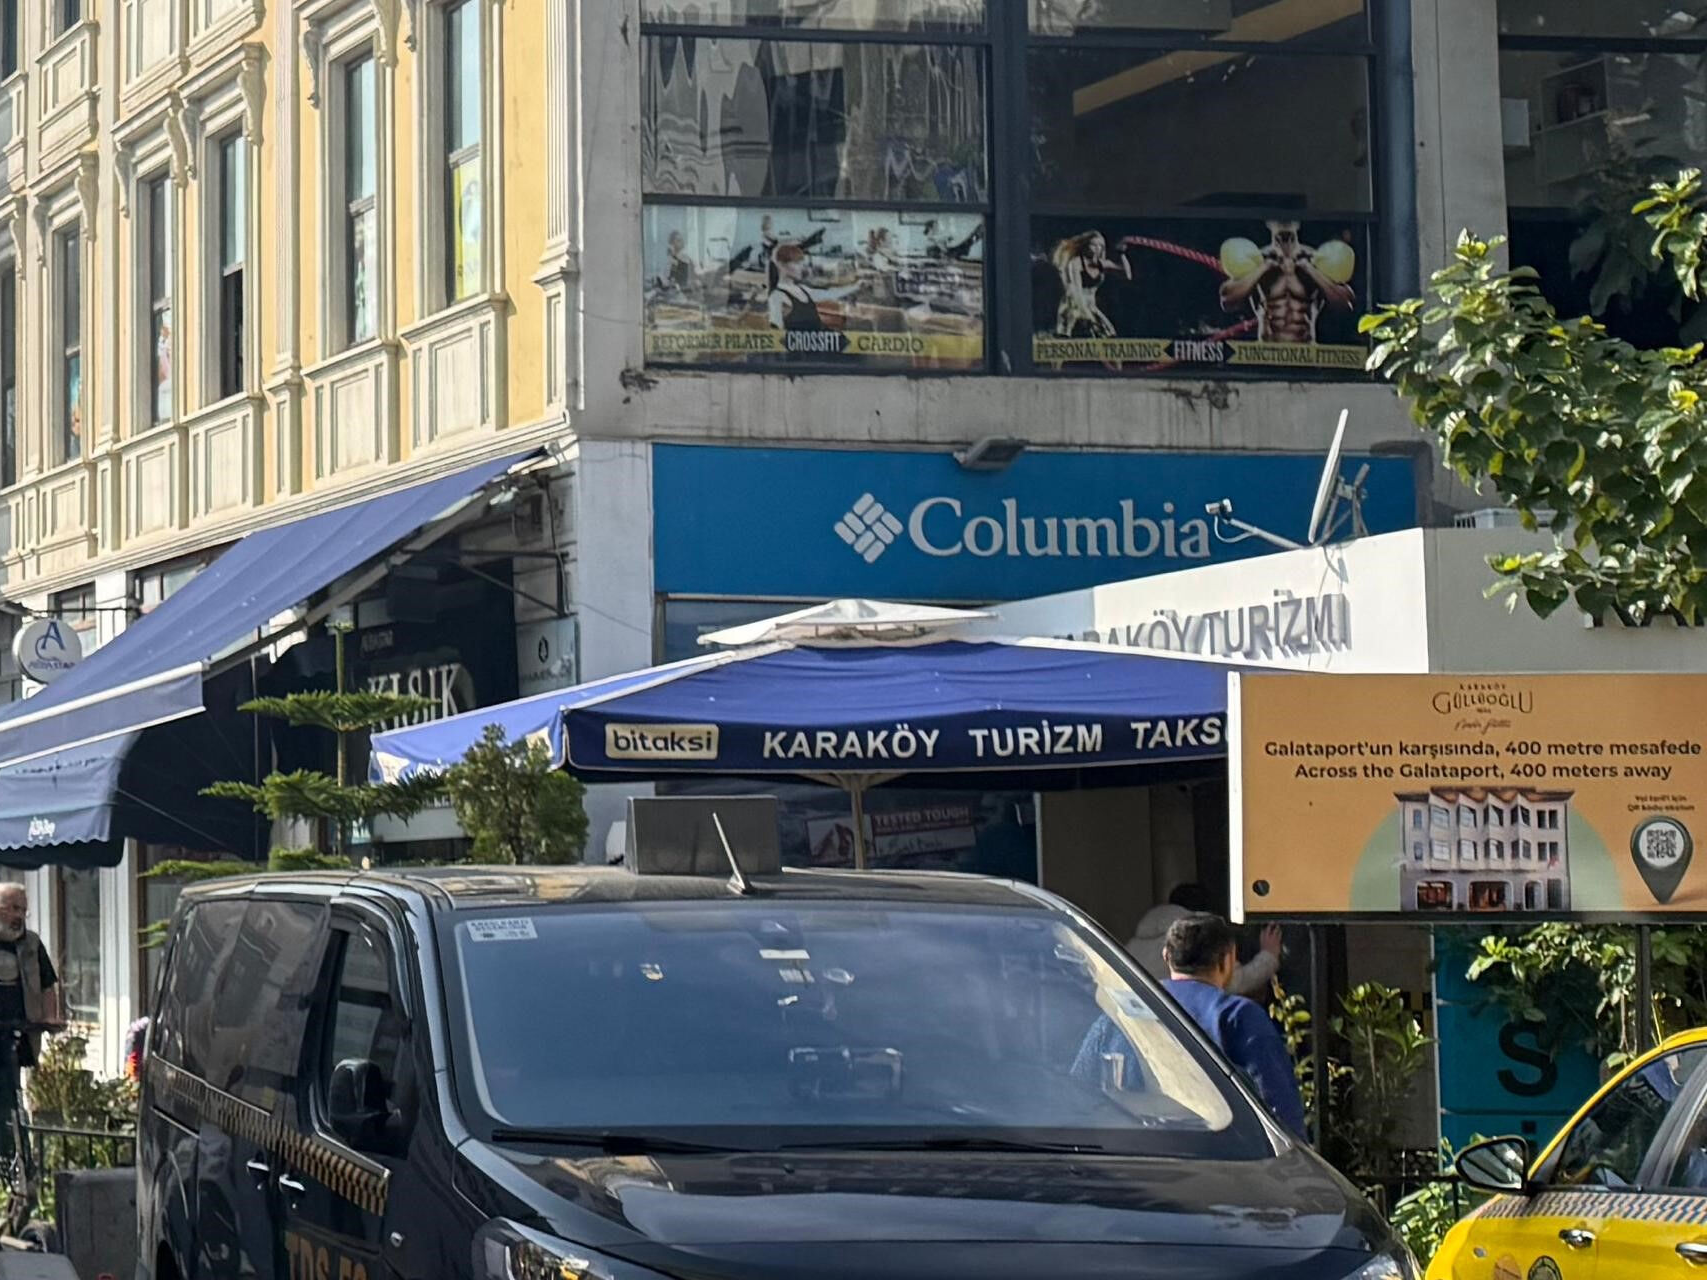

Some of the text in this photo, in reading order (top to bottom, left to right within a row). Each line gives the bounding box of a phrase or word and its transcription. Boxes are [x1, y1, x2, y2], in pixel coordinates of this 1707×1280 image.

[724, 332, 775, 350] PILATES
[787, 332, 841, 352] CROSSFIT
[857, 335, 924, 352] CARDIO
[1037, 342, 1162, 359] PERSONAL TRAINING
[1174, 342, 1224, 362] FITNESS
[1238, 345, 1361, 364] FUNCTIONAL FITNESS
[908, 496, 1211, 558] Columbia
[613, 727, 716, 753] bitaksi
[763, 717, 1228, 760] KARAKÖY TURİZM TAKS
[1264, 739, 1702, 760] Galataport'un karşısında, 400 metre mesafede
[1295, 762, 1672, 782] Across the Galataport, 400 meters away
